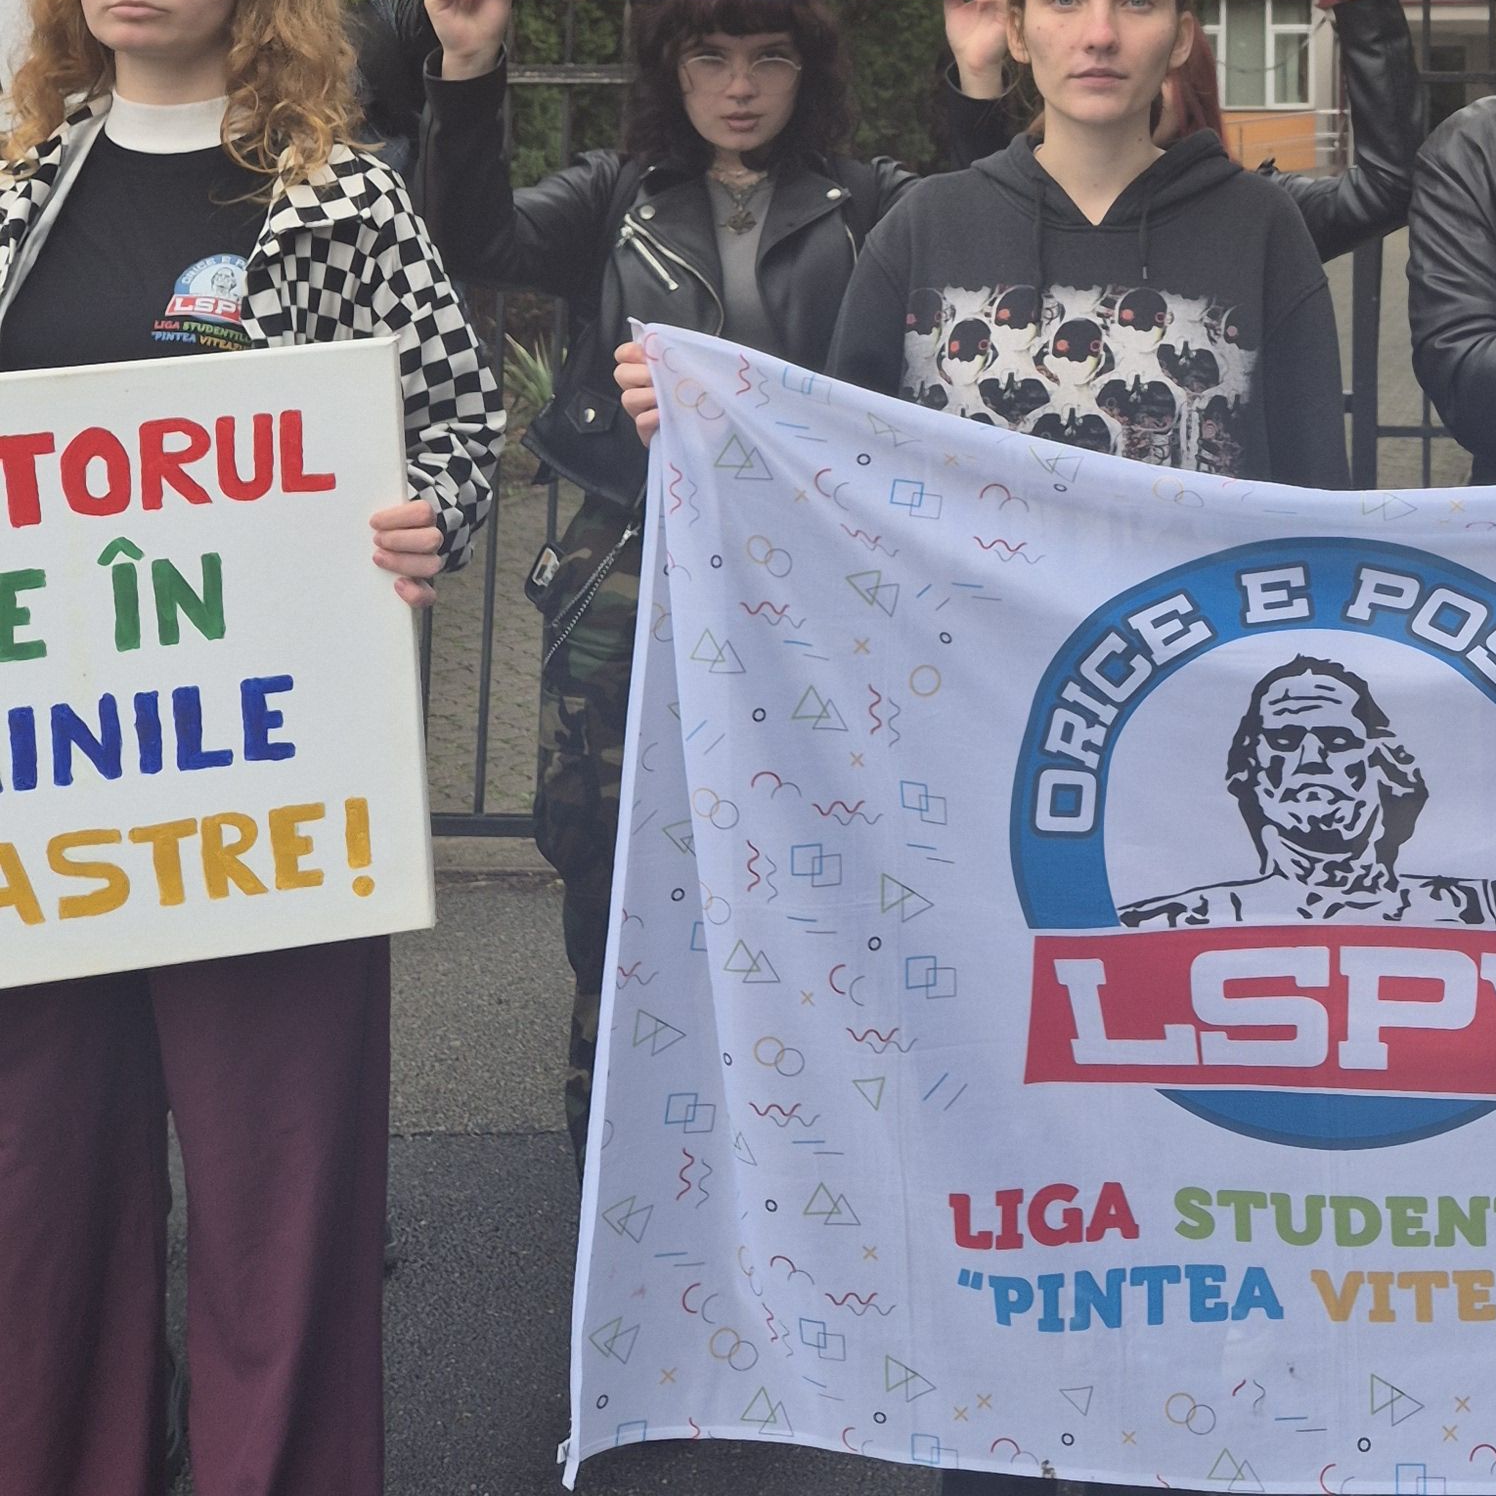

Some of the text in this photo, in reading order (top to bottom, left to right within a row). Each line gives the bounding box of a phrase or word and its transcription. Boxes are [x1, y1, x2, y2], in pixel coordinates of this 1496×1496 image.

[153, 319, 180, 330] LIGA
[173, 296, 241, 315] LSP
[97, 535, 227, 653] ÎN
[0, 674, 296, 794] INILE
[1034, 593, 1217, 834] ORICE
[1240, 565, 1311, 625] E
[948, 1180, 1141, 1250] LIGA
